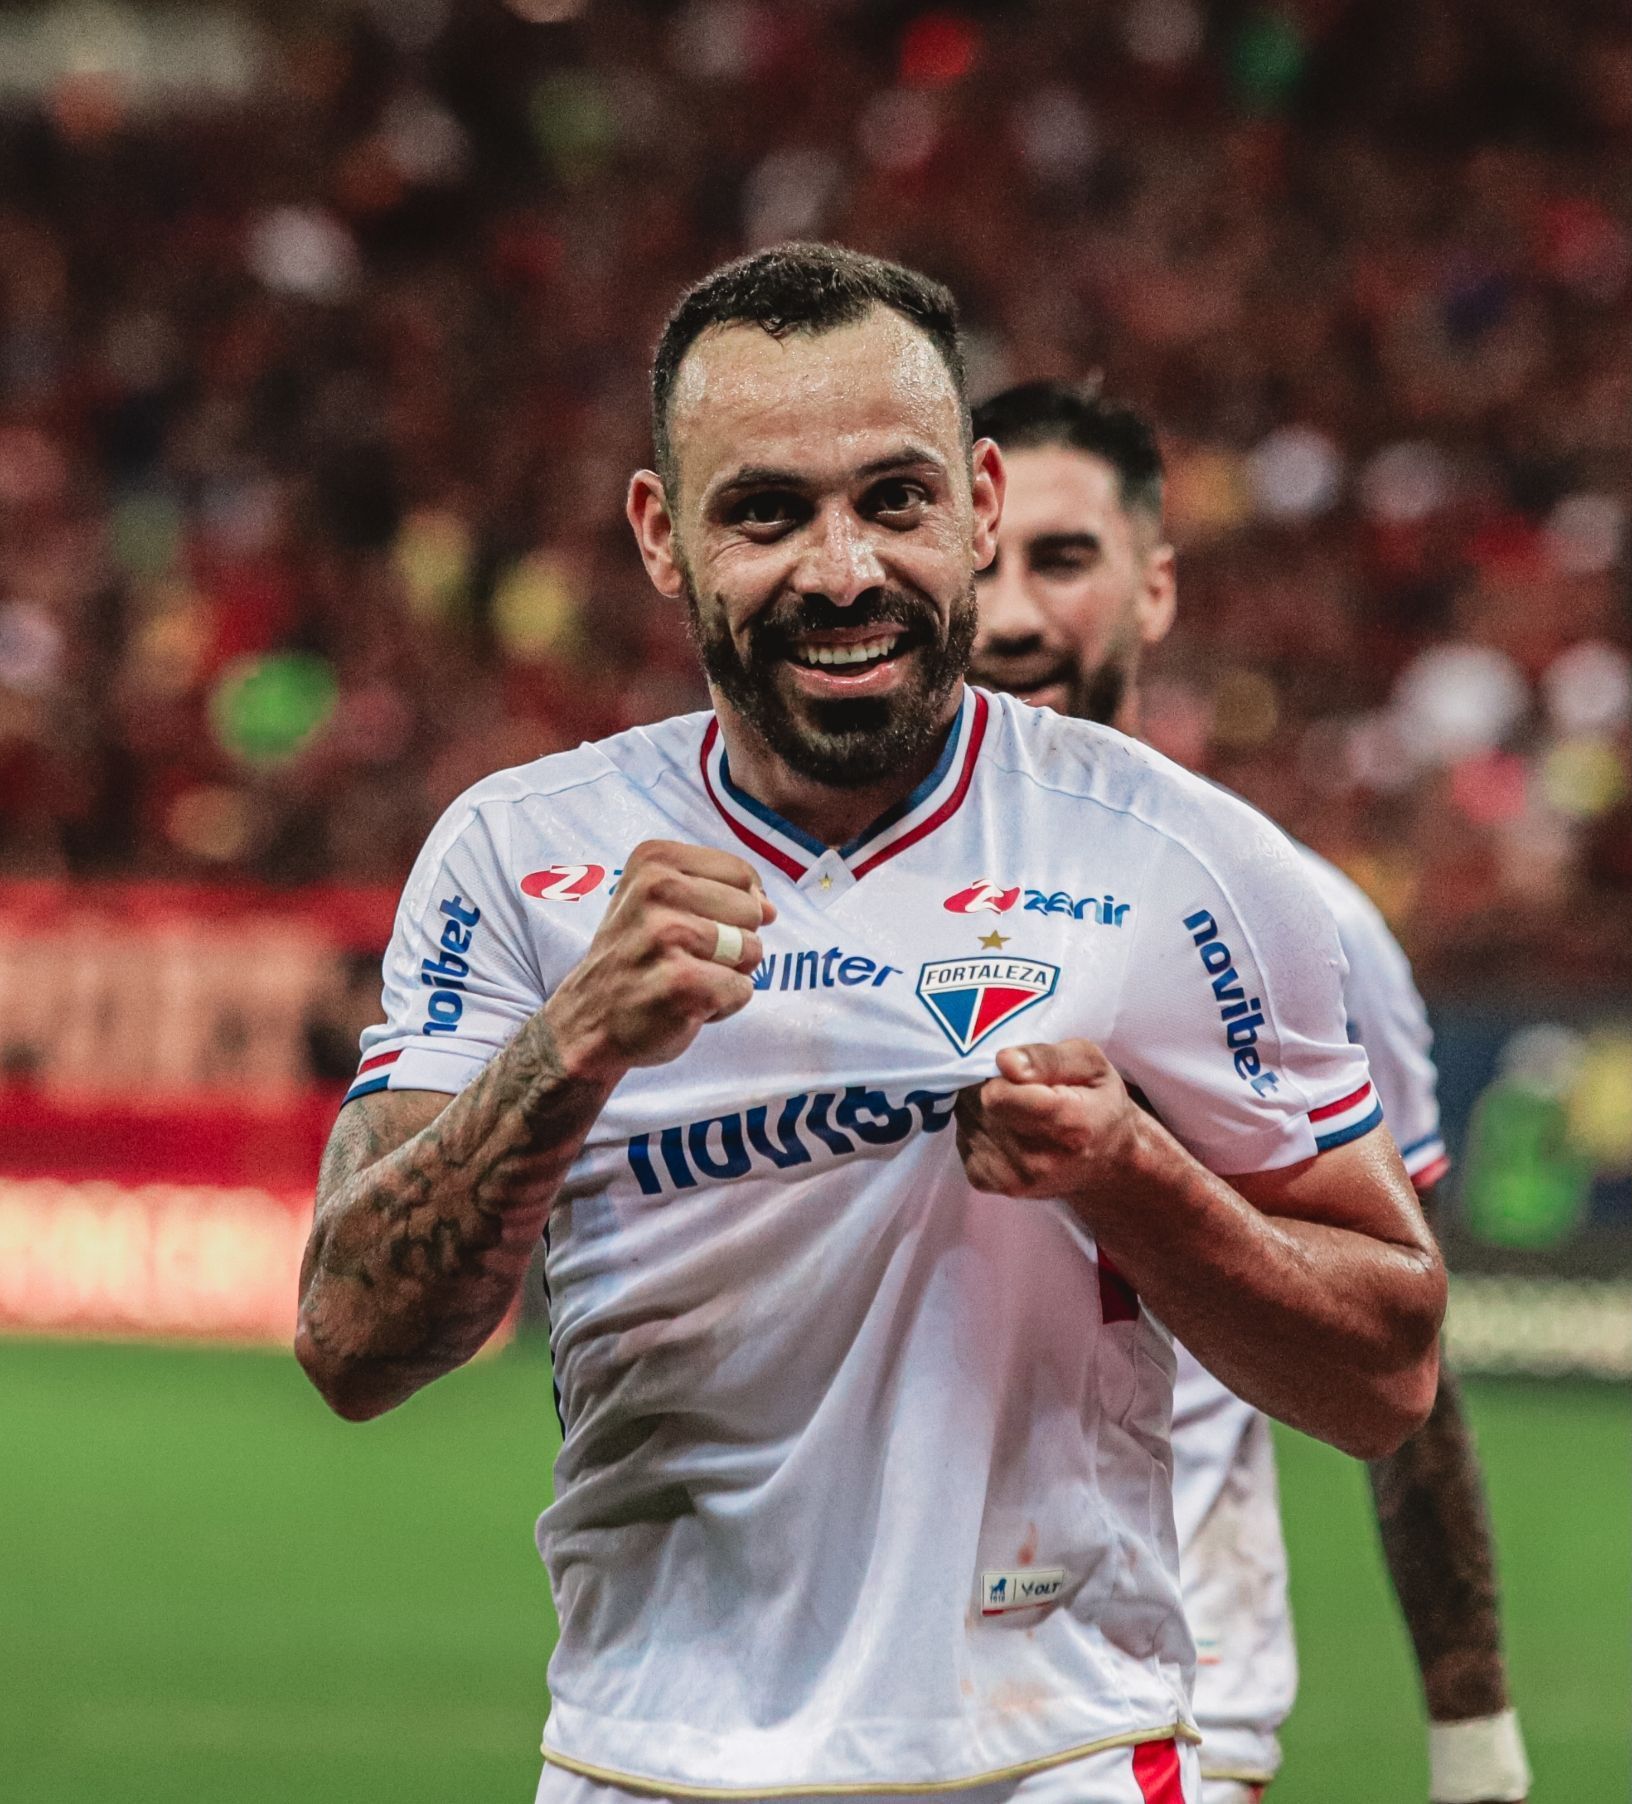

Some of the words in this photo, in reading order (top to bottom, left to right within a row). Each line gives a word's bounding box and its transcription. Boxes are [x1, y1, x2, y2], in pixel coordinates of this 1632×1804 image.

[1023, 889, 1131, 929] zenir
[924, 963, 1049, 986] FORTALEZA
[1182, 909, 1280, 1098] novibet
[627, 1086, 958, 1195] novibe
[1021, 1581, 1061, 1597] VOLT
